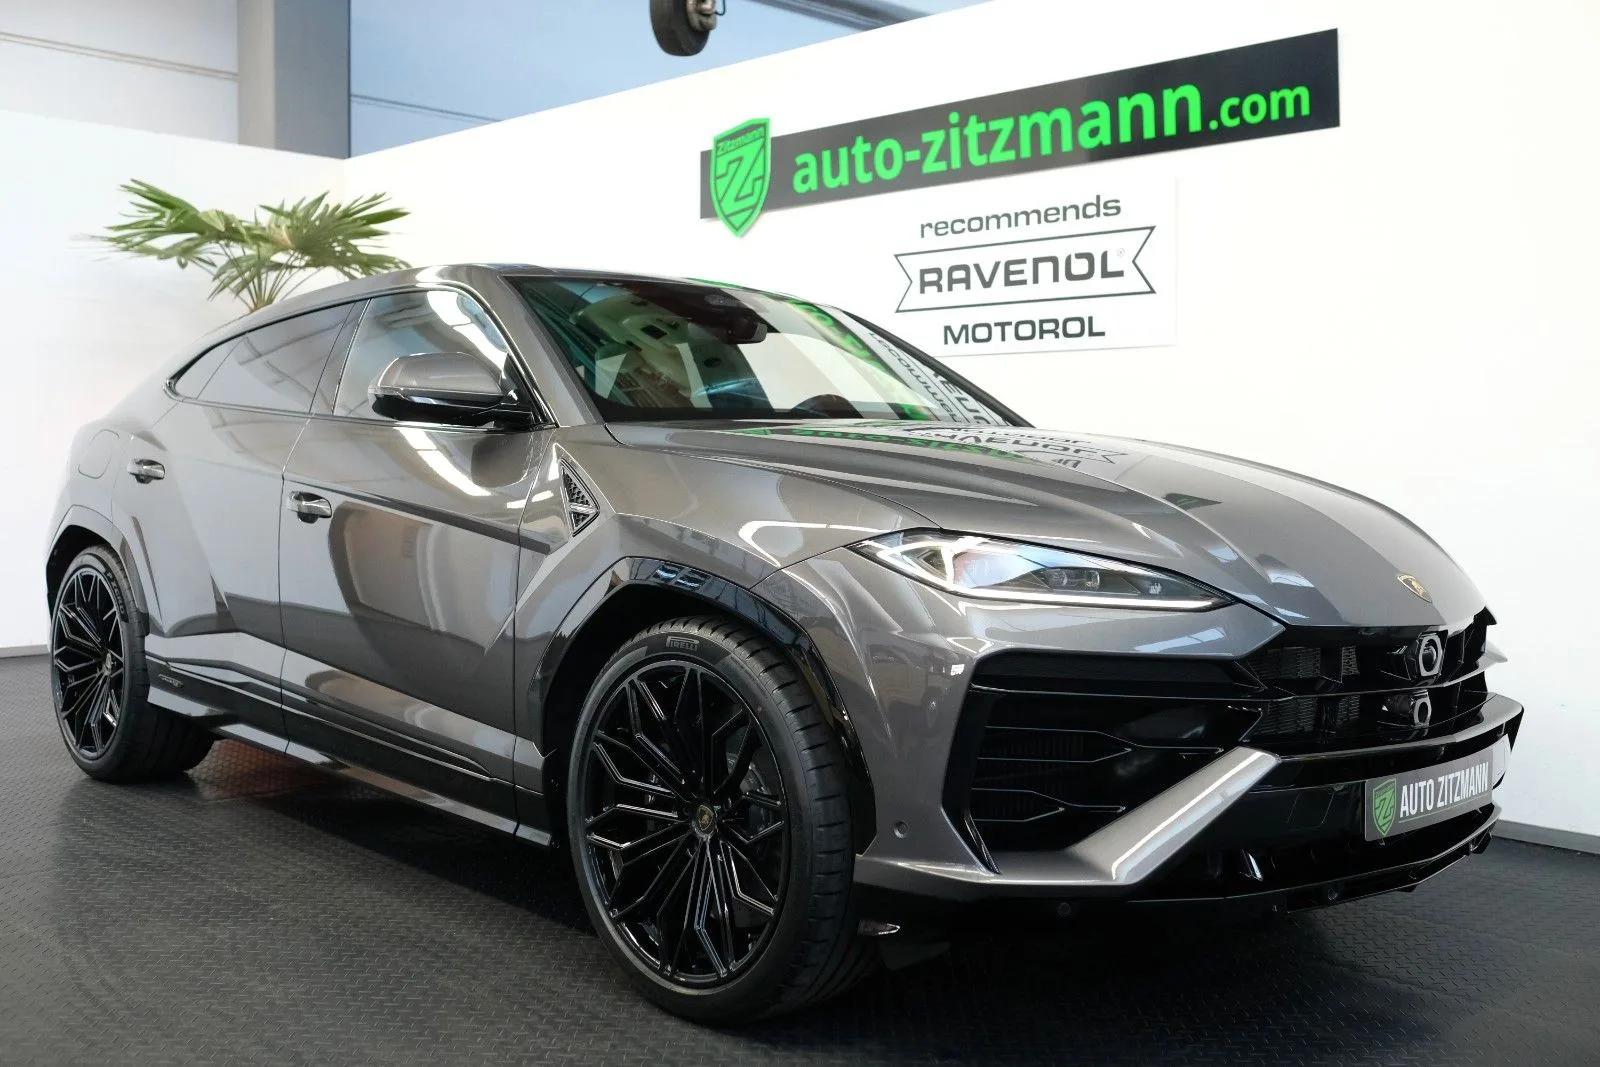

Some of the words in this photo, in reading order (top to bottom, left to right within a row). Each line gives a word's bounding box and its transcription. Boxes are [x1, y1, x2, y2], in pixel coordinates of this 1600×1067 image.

[792, 84, 1310, 195] auto-zitzmann.com
[920, 194, 1122, 238] recommends
[919, 250, 1125, 294] RAVENOL
[943, 315, 1106, 345] MOTOROL
[666, 635, 700, 651] PIRELLI
[1400, 778, 1435, 818] AUTO
[1436, 761, 1489, 808] ZITZMANN
